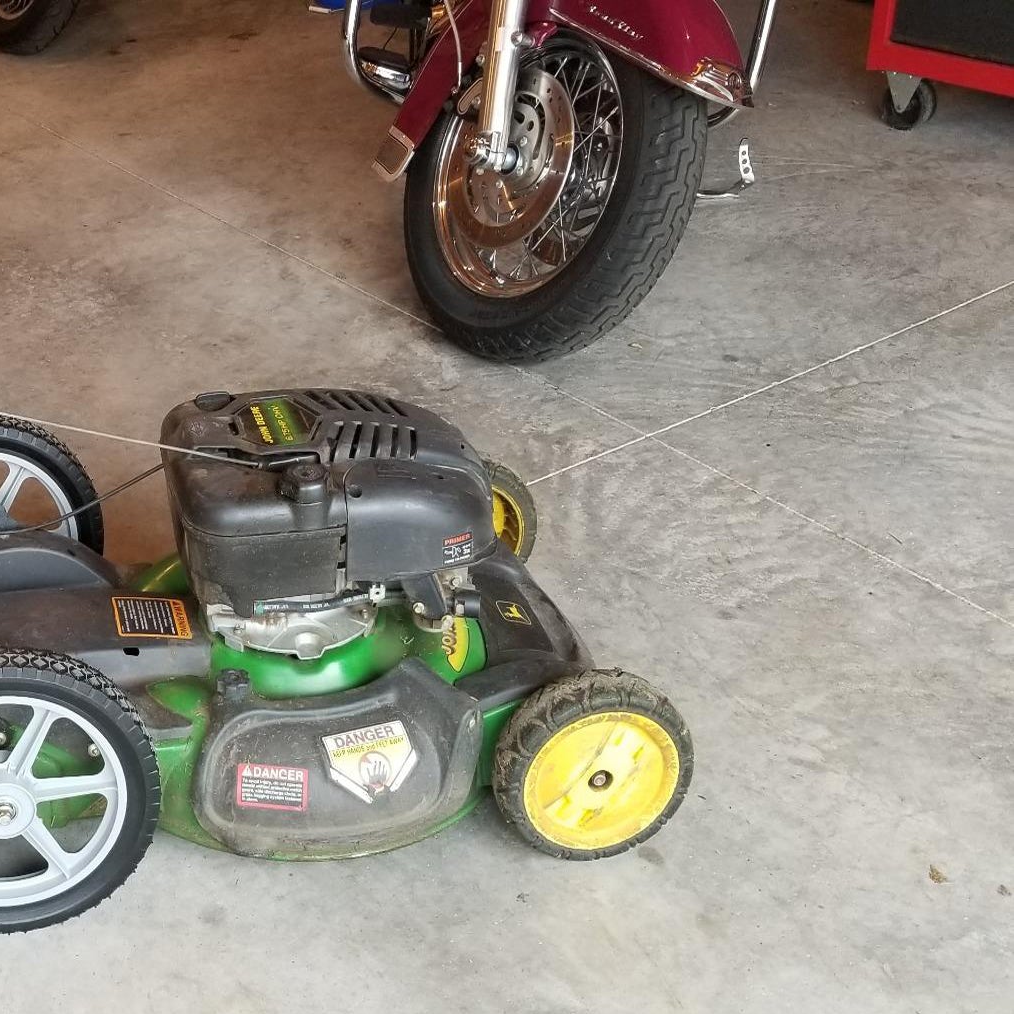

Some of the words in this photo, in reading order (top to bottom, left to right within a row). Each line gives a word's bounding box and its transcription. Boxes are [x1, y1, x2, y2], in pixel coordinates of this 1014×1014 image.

[250, 406, 266, 425] DEERE
[259, 426, 274, 444] JOHN
[444, 533, 471, 546] PRIMER
[334, 726, 395, 748] DANGER
[253, 766, 304, 781] DANGER
